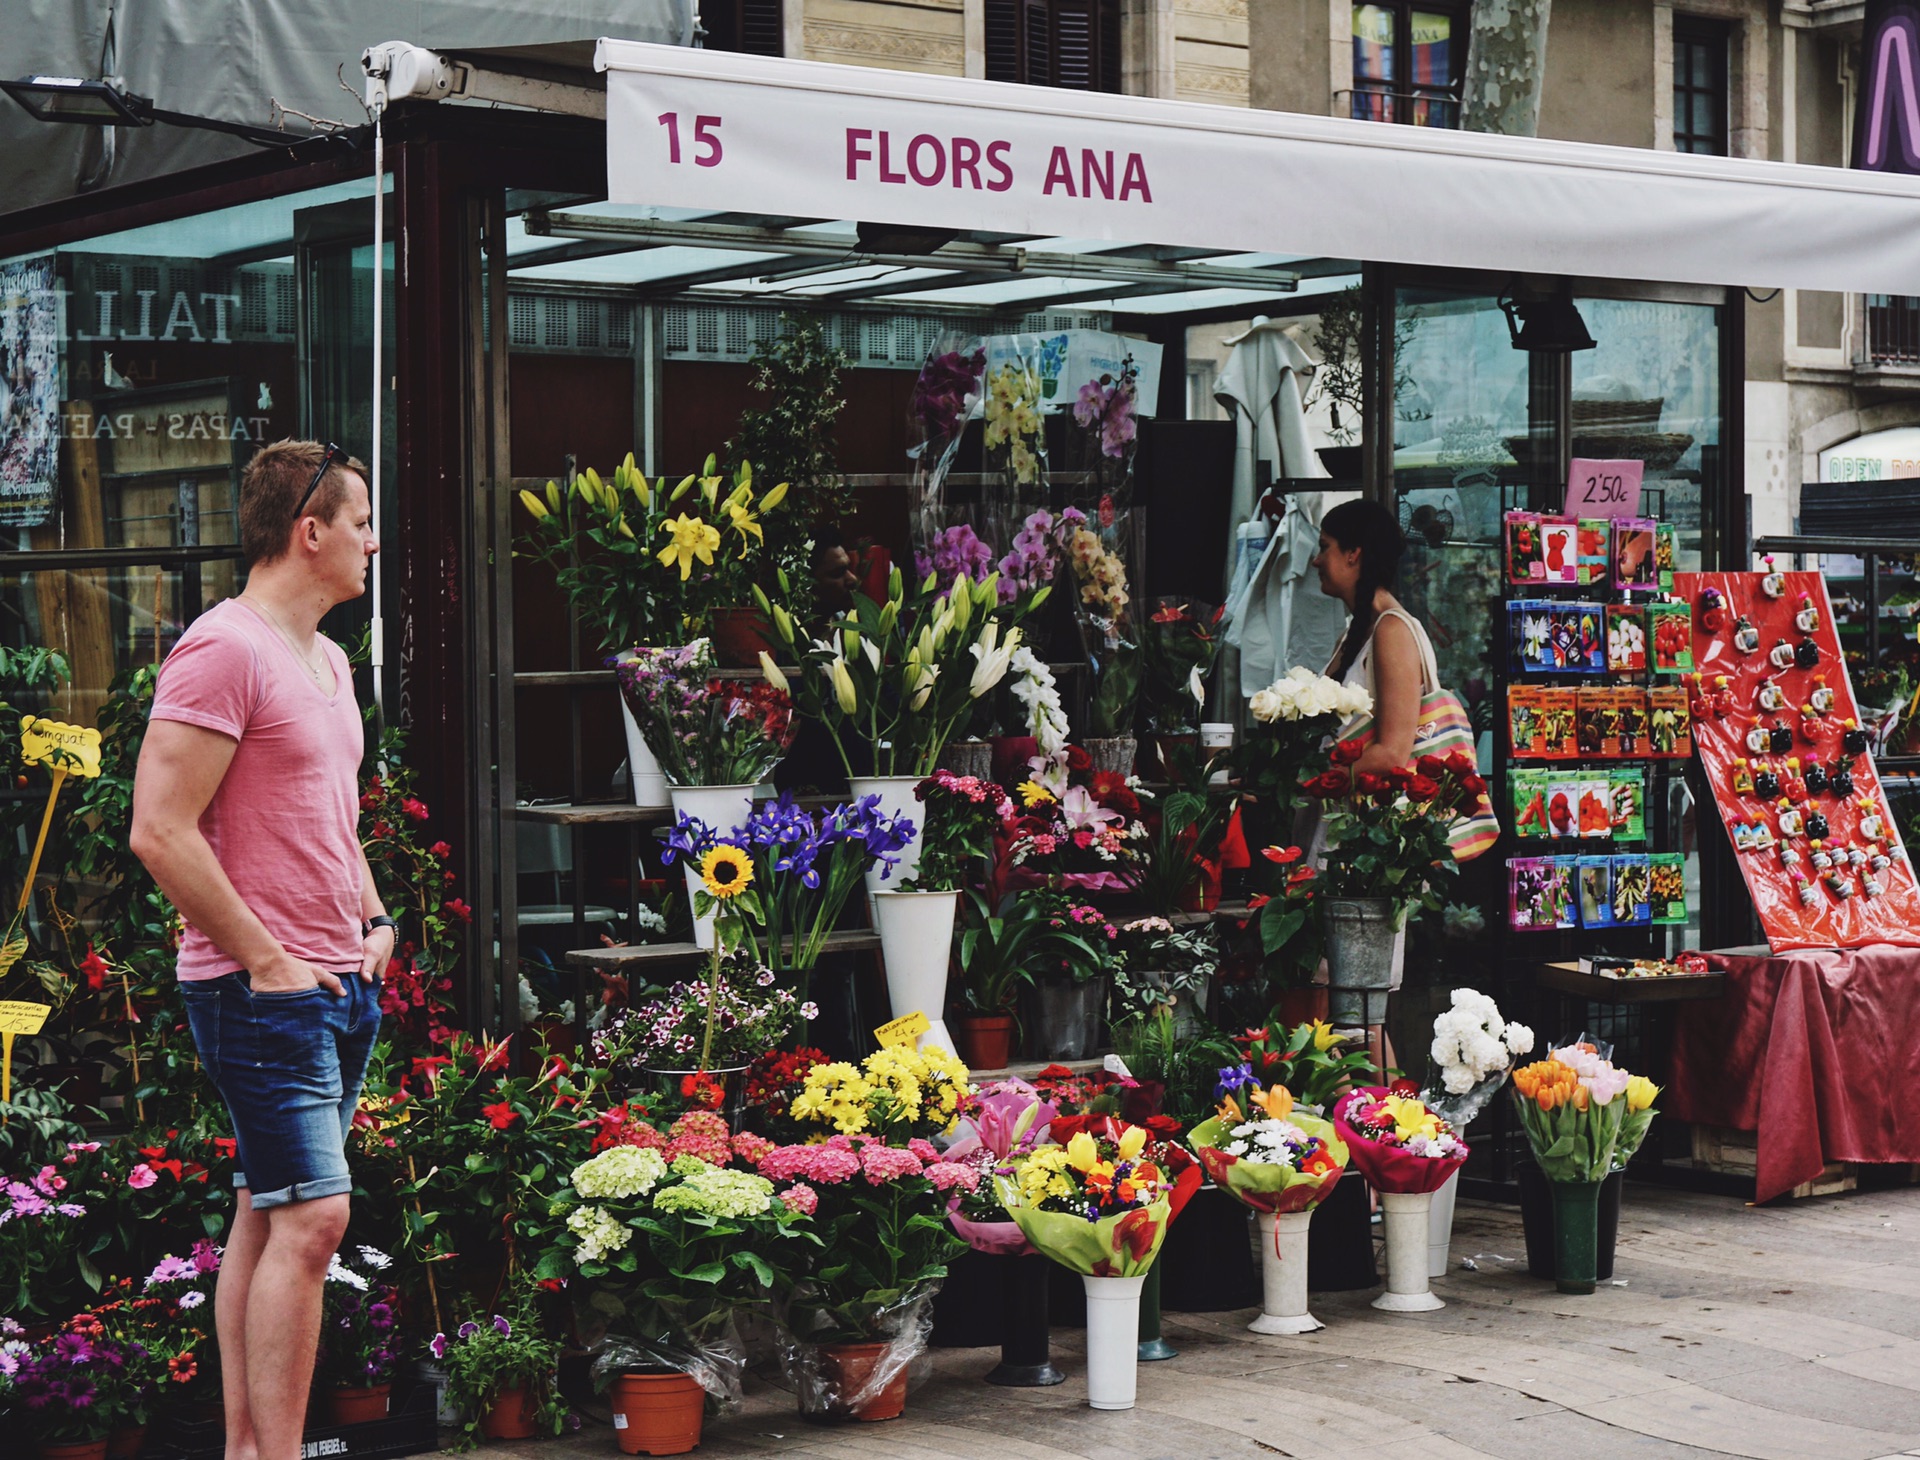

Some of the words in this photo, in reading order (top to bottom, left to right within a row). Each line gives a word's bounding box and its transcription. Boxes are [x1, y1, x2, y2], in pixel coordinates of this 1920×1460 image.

[657, 112, 723, 167] 15
[845, 127, 1015, 192] FLORS
[1042, 146, 1153, 203] ANA
[1829, 457, 1882, 482] OPEN
